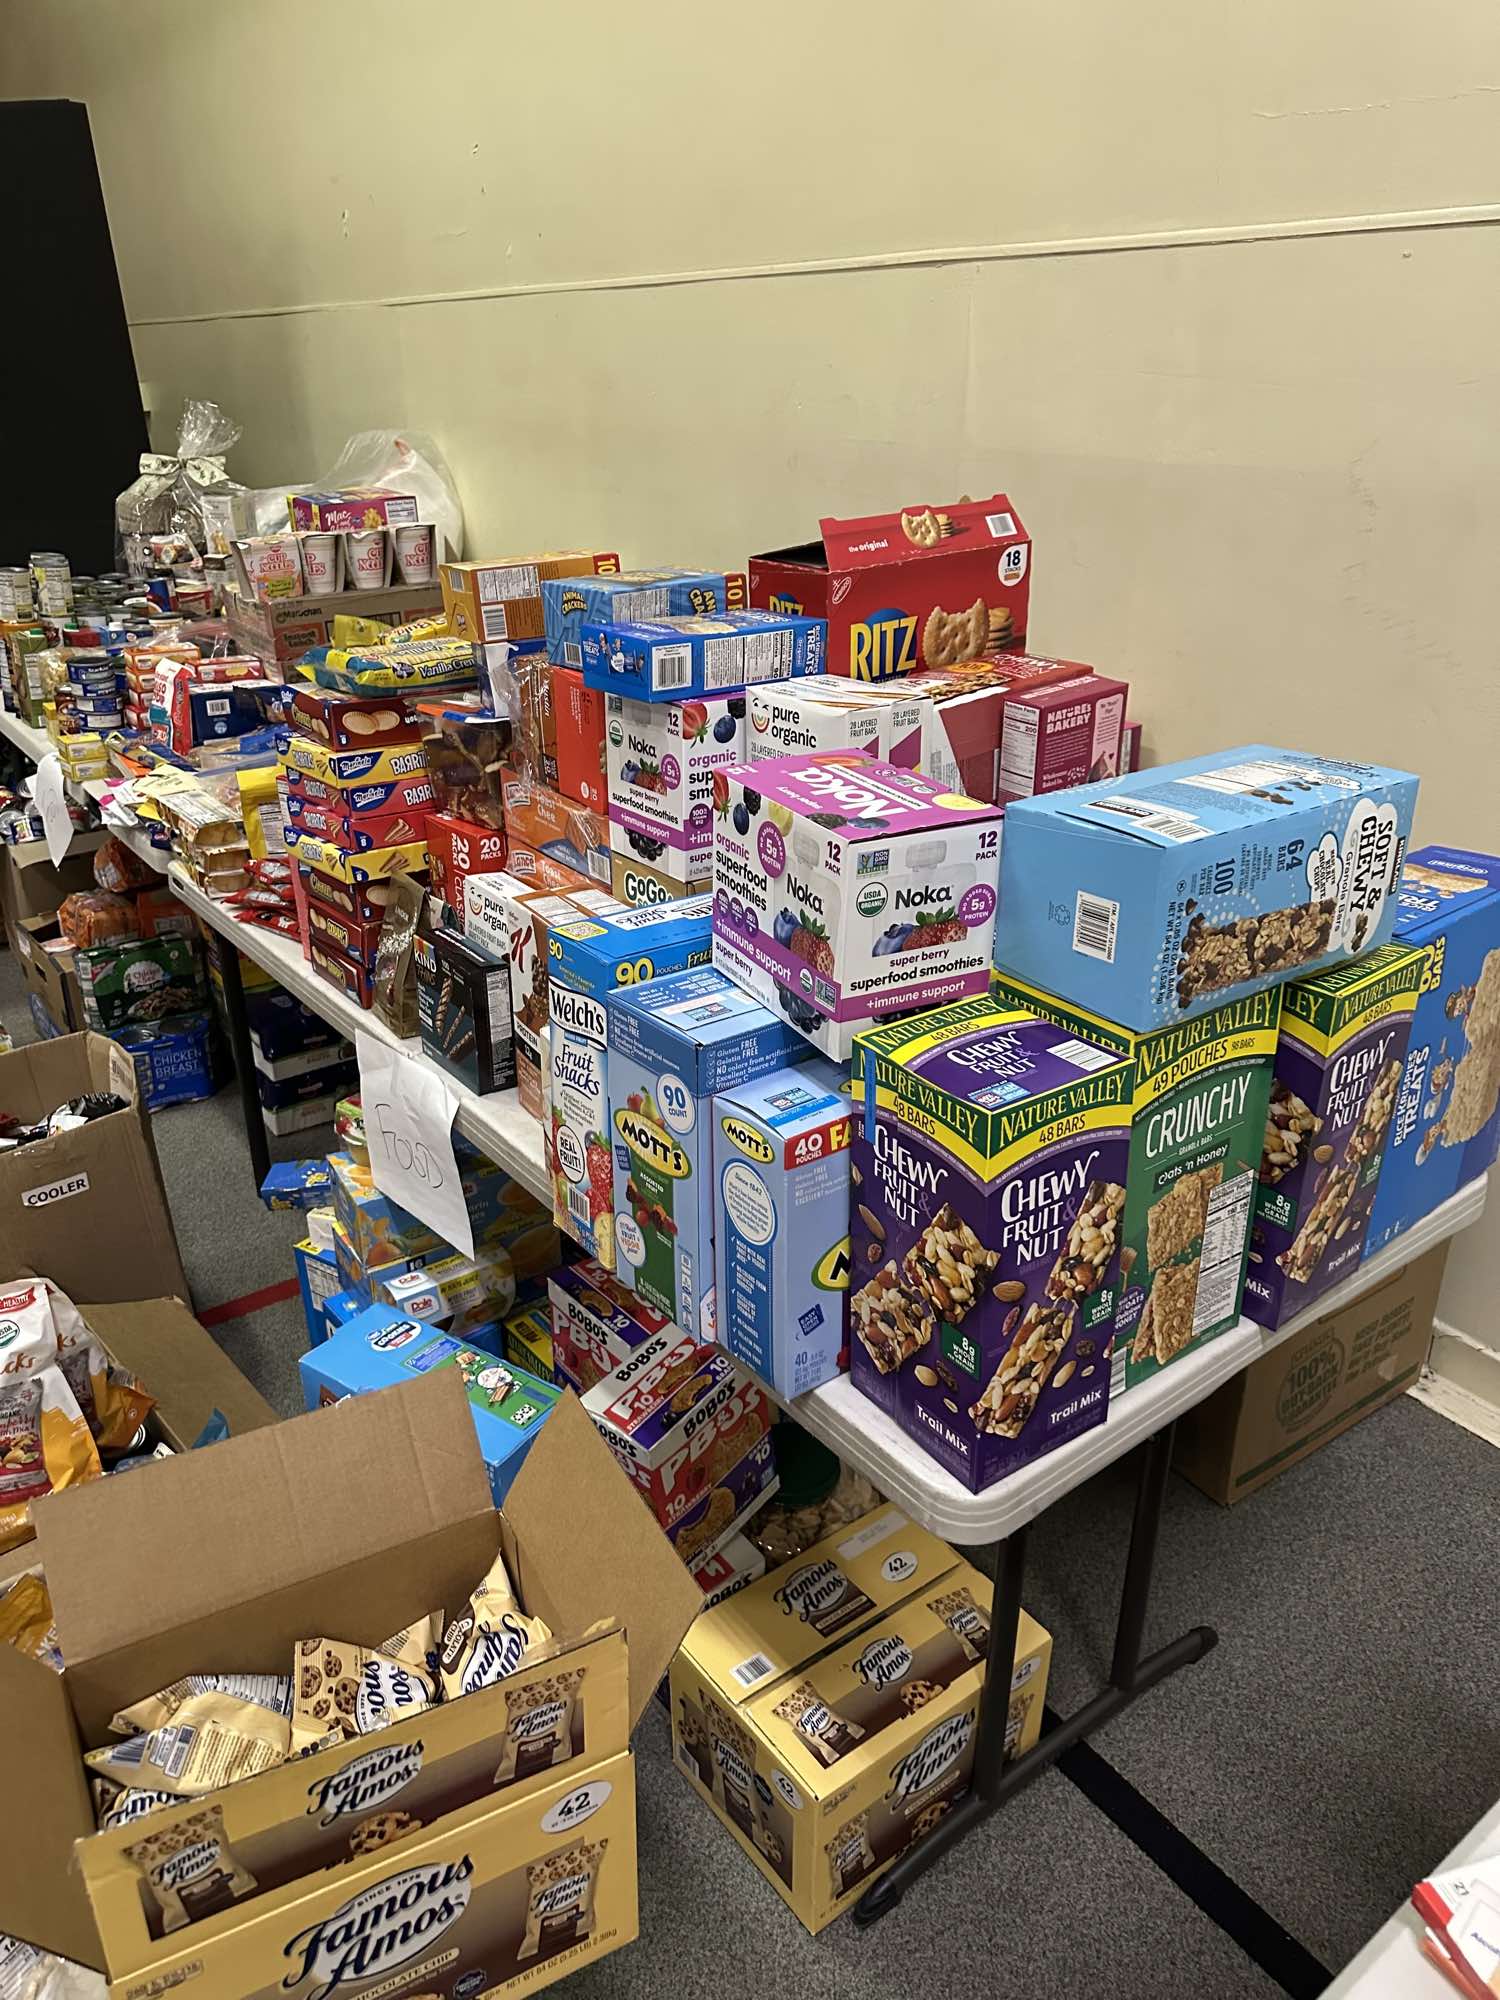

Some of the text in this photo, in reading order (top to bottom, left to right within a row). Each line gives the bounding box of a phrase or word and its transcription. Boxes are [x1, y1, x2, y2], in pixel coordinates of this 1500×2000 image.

[859, 539, 889, 552] original
[1005, 549, 1021, 566] 18
[562, 592, 584, 602] ANIMAL
[727, 577, 744, 599] 10
[805, 628, 815, 674] TREATS
[850, 616, 918, 682] RITZ
[668, 713, 679, 727] 12
[772, 704, 800, 726] pure
[900, 708, 921, 719] LAYERED
[1046, 713, 1092, 734] BAKERY
[628, 734, 657, 758] Noka
[771, 725, 817, 749] organic
[689, 749, 737, 767] organic
[612, 792, 679, 825] superfood smoothies
[458, 838, 470, 870] 20
[480, 837, 500, 854] 20
[715, 832, 750, 861] organic
[766, 838, 777, 858] 5g
[827, 841, 841, 863] 12
[978, 830, 998, 849] 12
[1285, 838, 1305, 871] 64
[1370, 820, 1393, 883] SOFT
[480, 849, 501, 861] PACKS
[761, 855, 781, 872] PROTEIN
[824, 860, 841, 876] PACK
[975, 850, 998, 861] PACK
[1276, 846, 1286, 872] BARS
[1349, 815, 1378, 913] CHEWY
[1391, 839, 1405, 893] KIRKLAND
[715, 850, 768, 893] superfood
[1213, 858, 1236, 895] 100
[1318, 850, 1326, 901] CHOCOLATE
[1342, 851, 1354, 900] Granola
[715, 868, 767, 912] smoothies
[786, 873, 824, 915] Noka
[863, 888, 882, 900] USDA
[895, 885, 952, 910] Noka
[971, 898, 986, 912] 5g
[484, 896, 504, 916] pure
[964, 909, 990, 921] PROTEIN
[414, 950, 437, 973] KIND
[548, 938, 563, 961] 90
[715, 919, 755, 955] +immune
[755, 948, 792, 982] support
[715, 941, 754, 978] super berry
[890, 947, 950, 968] super berry
[1430, 935, 1447, 991] BARS
[615, 958, 655, 987] 90
[850, 955, 985, 993] superfood smoothies
[866, 980, 966, 1010] +immune support
[1340, 963, 1420, 1027] NATURE VALLEY
[1372, 999, 1393, 1018] BARS
[549, 989, 606, 1036] Welch's
[872, 998, 1008, 1052] NATURE VALLEY
[516, 1020, 539, 1047] PROTEIN
[931, 1020, 980, 1042] 48 BARS
[1136, 990, 1277, 1084] NATURE VALLEY
[562, 1043, 594, 1073] Fruit
[717, 1037, 758, 1058] Gluten FREE
[742, 1046, 759, 1057] FREE
[946, 1030, 1024, 1067] CHEWY
[1330, 1031, 1396, 1094] CHEWY
[155, 1060, 199, 1079] BREAST
[554, 1055, 601, 1096] Snacks
[716, 1065, 727, 1074] NO
[971, 1051, 1017, 1076] FRUIT
[995, 1058, 1036, 1080] NUT
[1152, 1040, 1228, 1093] 49 POUCHES
[663, 1083, 686, 1109] 90
[1326, 1076, 1367, 1116] FRUIT
[1394, 1049, 1418, 1147] RICE KRISPIES
[1401, 1045, 1430, 1139] TREATS
[668, 1107, 688, 1120] COUNT
[893, 1095, 937, 1137] 48 BARS
[918, 1085, 979, 1145] VALLEY
[999, 1071, 1128, 1149] NATURE VALLEY
[1146, 1071, 1253, 1159] CRUNCHY
[1331, 1098, 1365, 1132] NUT
[1038, 1113, 1087, 1144] 48 BARS
[375, 1103, 444, 1189] FOOD
[560, 1136, 578, 1155] REAL
[795, 1133, 823, 1157] 40
[873, 1123, 949, 1195] CHEWY
[1158, 1144, 1229, 1185] Oats Honey
[27, 1177, 87, 1206] COOLER
[873, 1158, 920, 1205] FRUIT
[1001, 1151, 1100, 1223] CHEWY
[885, 1188, 920, 1228] NUT
[1275, 1194, 1291, 1211] 8g
[1002, 1202, 1064, 1248] FRUIT
[1015, 1226, 1064, 1266] NUT
[1100, 1290, 1113, 1304] 8g
[1244, 1278, 1272, 1300] Mix
[568, 1303, 609, 1346] BOBO'S
[612, 1314, 631, 1329] 10
[1091, 1306, 1112, 1321] GRAIN
[616, 1337, 668, 1382] BOBO'S
[795, 1351, 808, 1367] 40
[952, 1342, 976, 1363] WHOLE
[953, 1351, 976, 1370] GRAIN
[962, 1337, 976, 1356] 8g
[710, 1357, 729, 1373] 10
[634, 1395, 655, 1411] 10
[683, 1379, 736, 1438] BOBO'S
[1050, 1390, 1102, 1424] Trail Mix
[916, 1404, 969, 1455] Trail Mix
[754, 1445, 771, 1464] 10
[665, 1494, 686, 1515] 10
[888, 1557, 907, 1573] 42
[773, 1559, 838, 1616] Famous
[800, 1577, 843, 1623] Amos
[852, 1634, 905, 1685] Famous
[875, 1651, 911, 1692] Amos
[507, 1700, 568, 1736] Famous
[888, 1706, 977, 1801] Famous
[307, 1739, 425, 1815] Famous
[884, 1740, 970, 1812] Amos
[318, 1767, 419, 1829] Amos
[558, 1792, 592, 1818] 42
[150, 1836, 221, 1885] Famous
[166, 1852, 217, 1891] Amos
[357, 1886, 392, 1907] SINCE
[282, 1854, 475, 1988] Famous
[305, 1896, 465, 2000] Amos
